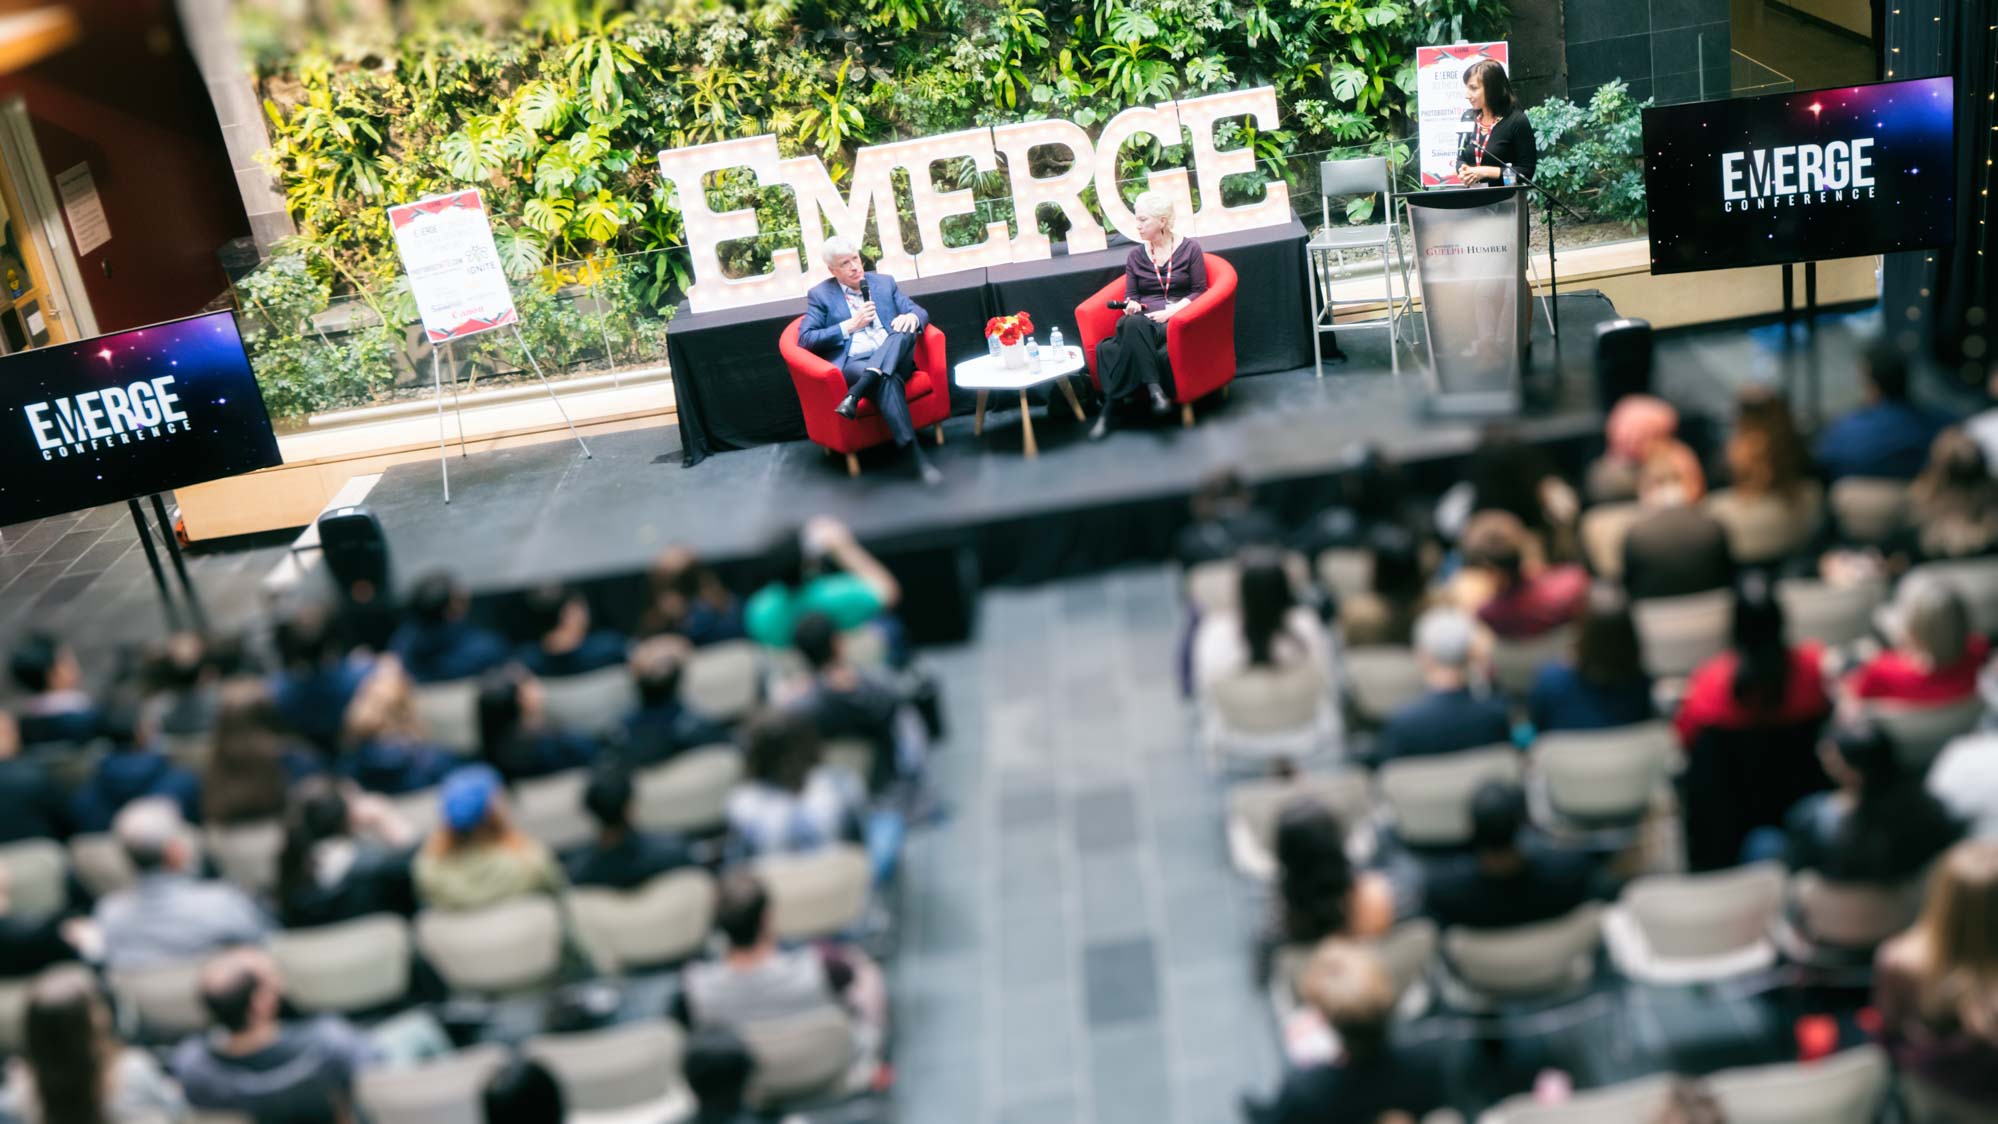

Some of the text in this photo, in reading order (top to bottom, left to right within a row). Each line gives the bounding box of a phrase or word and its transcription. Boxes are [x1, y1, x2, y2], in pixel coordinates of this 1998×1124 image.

[1722, 137, 1875, 201] EMERGE
[658, 85, 1291, 314] EMERGE
[1724, 187, 1875, 212] CONFERENCE
[466, 261, 497, 275] IGNITE
[1466, 245, 1508, 255] HUMBER
[24, 375, 188, 450] EMERGE
[42, 419, 192, 461] CONFERENCE
